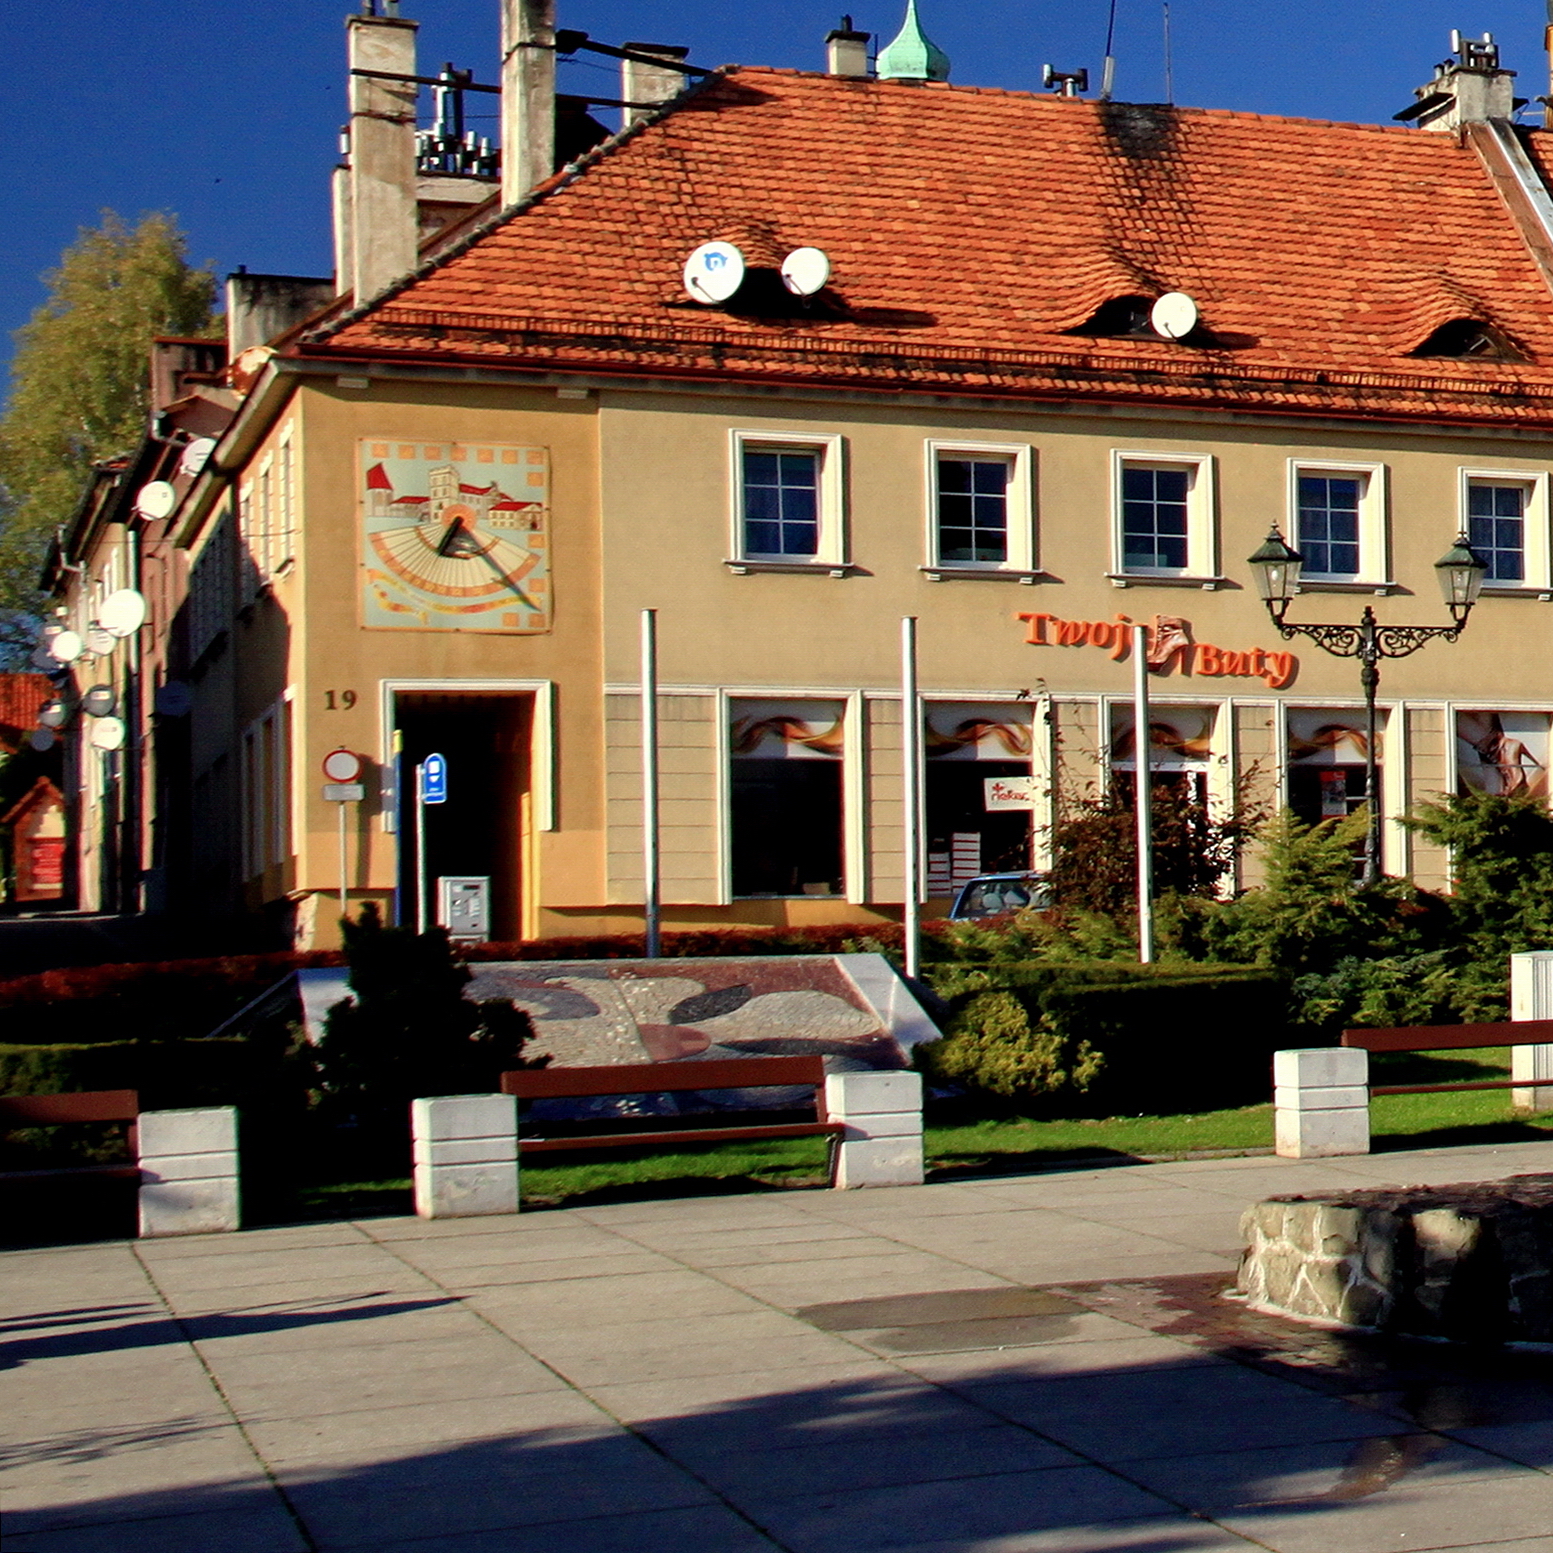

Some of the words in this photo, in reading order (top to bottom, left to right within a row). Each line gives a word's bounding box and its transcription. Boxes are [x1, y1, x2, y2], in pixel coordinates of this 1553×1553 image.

[1014, 612, 1148, 660] Twoj
[1196, 644, 1293, 688] Buty
[324, 689, 357, 710] 19
